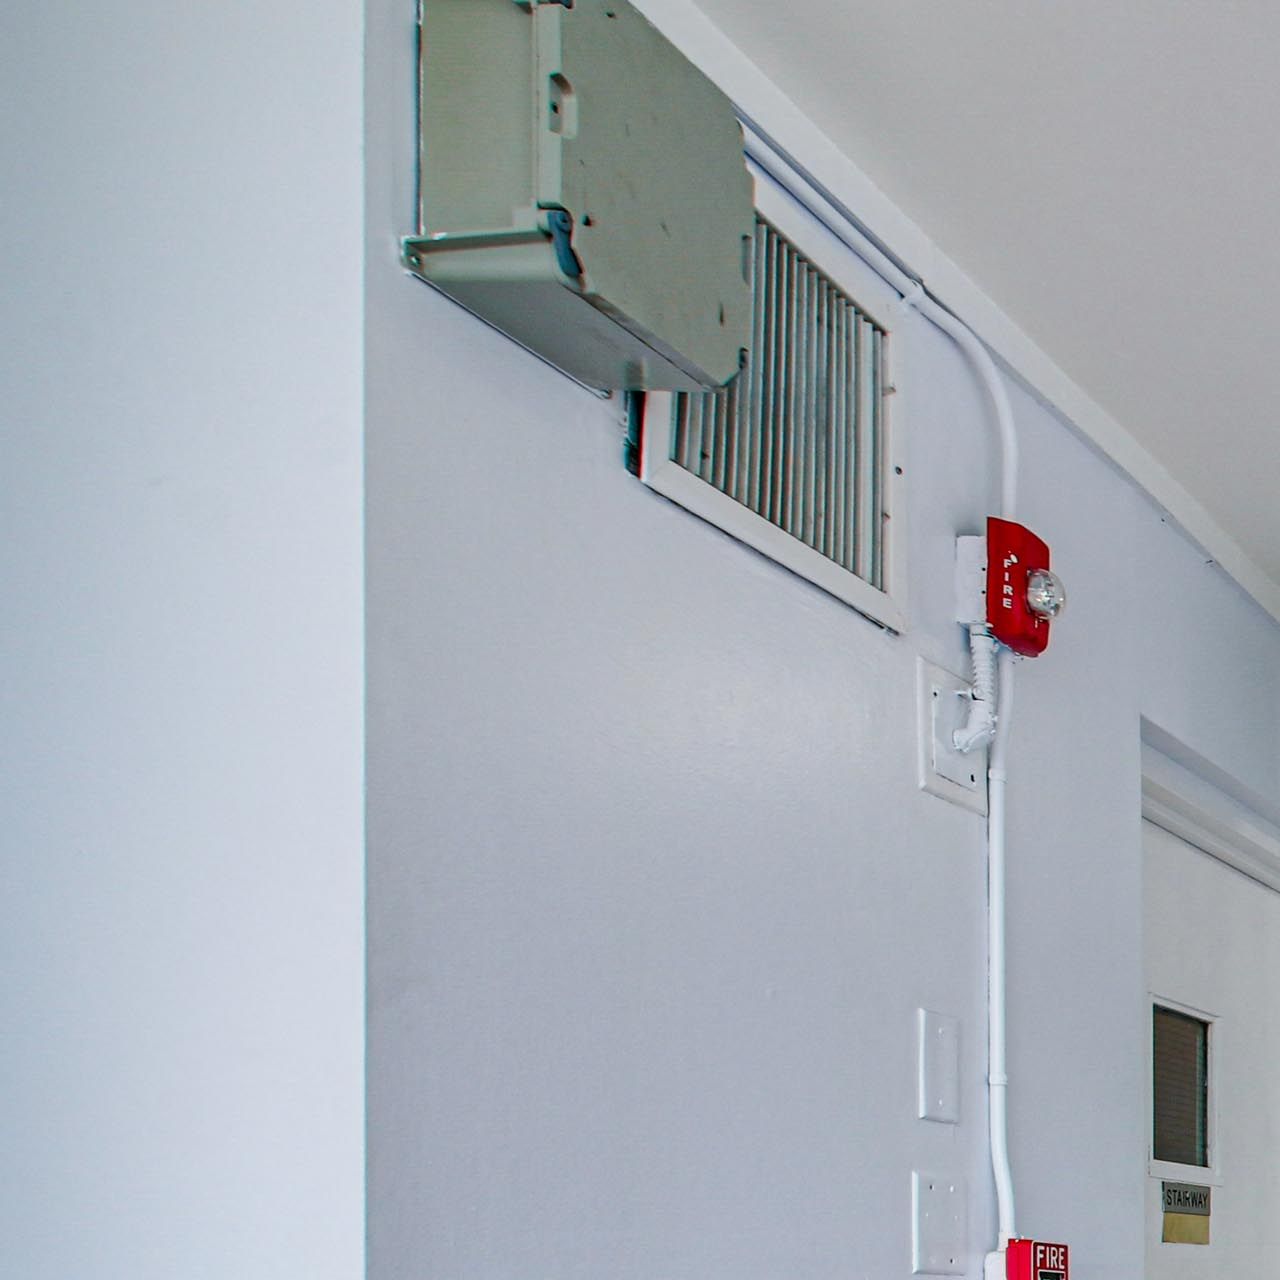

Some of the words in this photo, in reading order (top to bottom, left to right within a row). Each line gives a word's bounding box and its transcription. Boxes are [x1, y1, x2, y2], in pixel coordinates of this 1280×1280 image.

[1003, 558, 1013, 609] FIRE
[1166, 1188, 1208, 1209] STAIRWAY
[1036, 1246, 1065, 1270] FIRE
